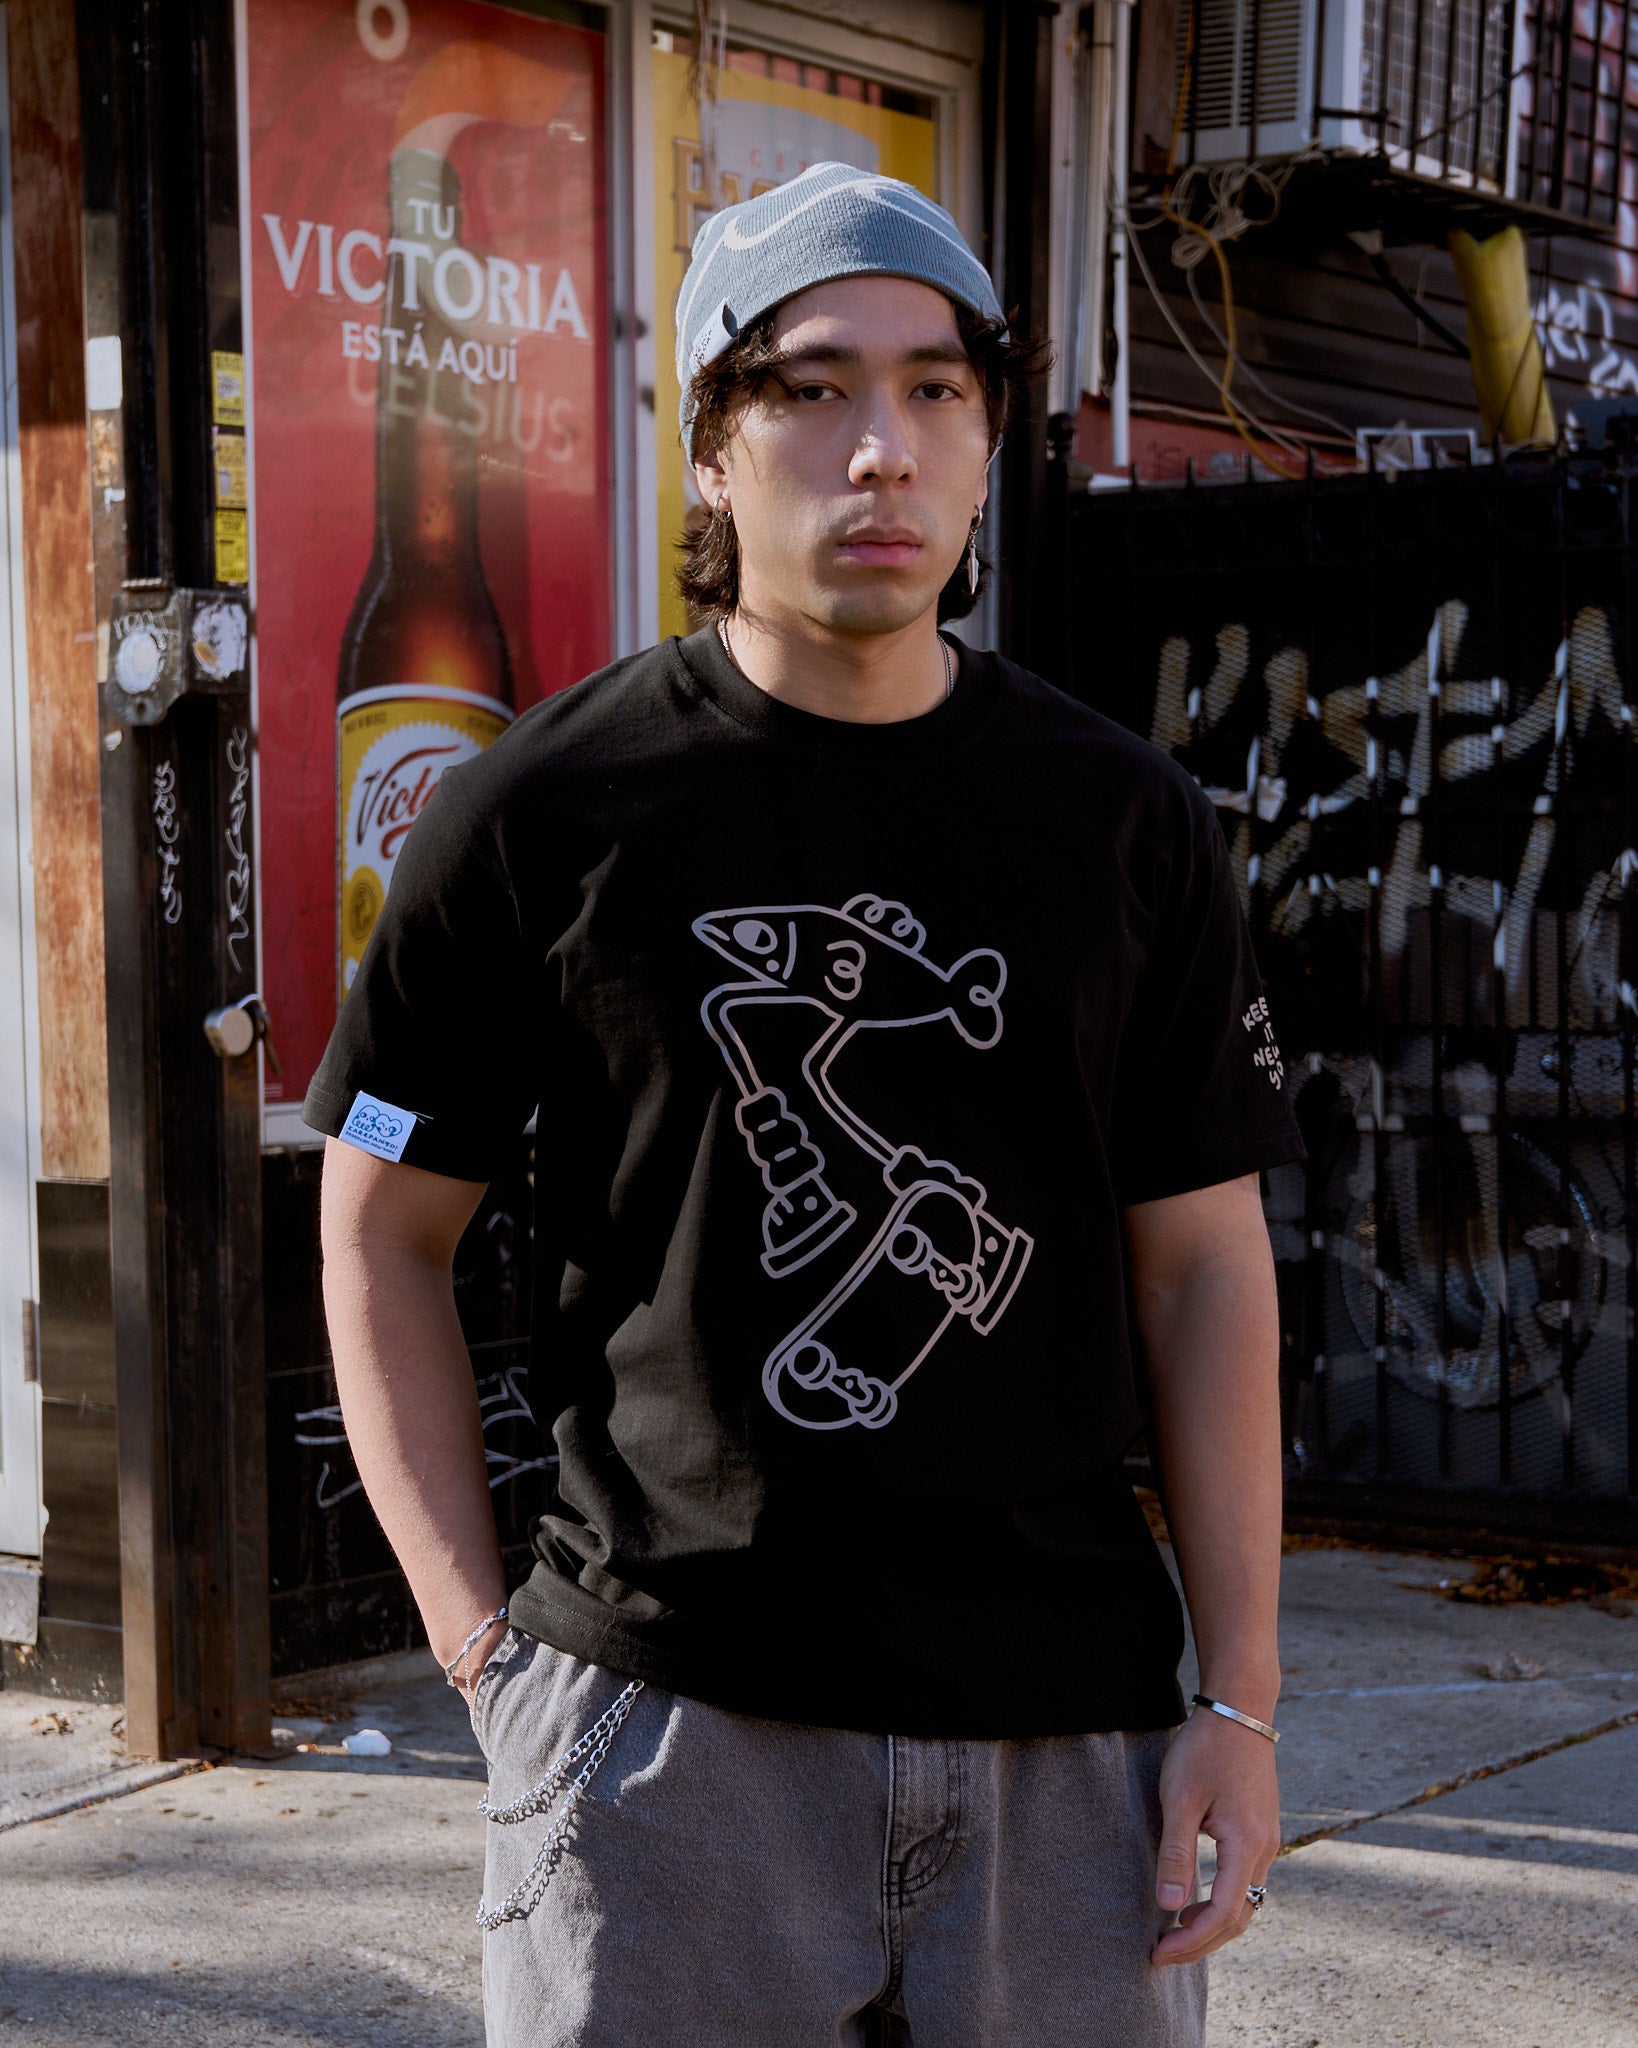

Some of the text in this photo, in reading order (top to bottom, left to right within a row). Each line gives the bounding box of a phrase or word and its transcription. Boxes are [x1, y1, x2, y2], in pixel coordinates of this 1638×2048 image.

[406, 198, 456, 240] TU
[261, 213, 590, 340] VICTORIA
[341, 321, 518, 385] ESTÁ AQUÍ
